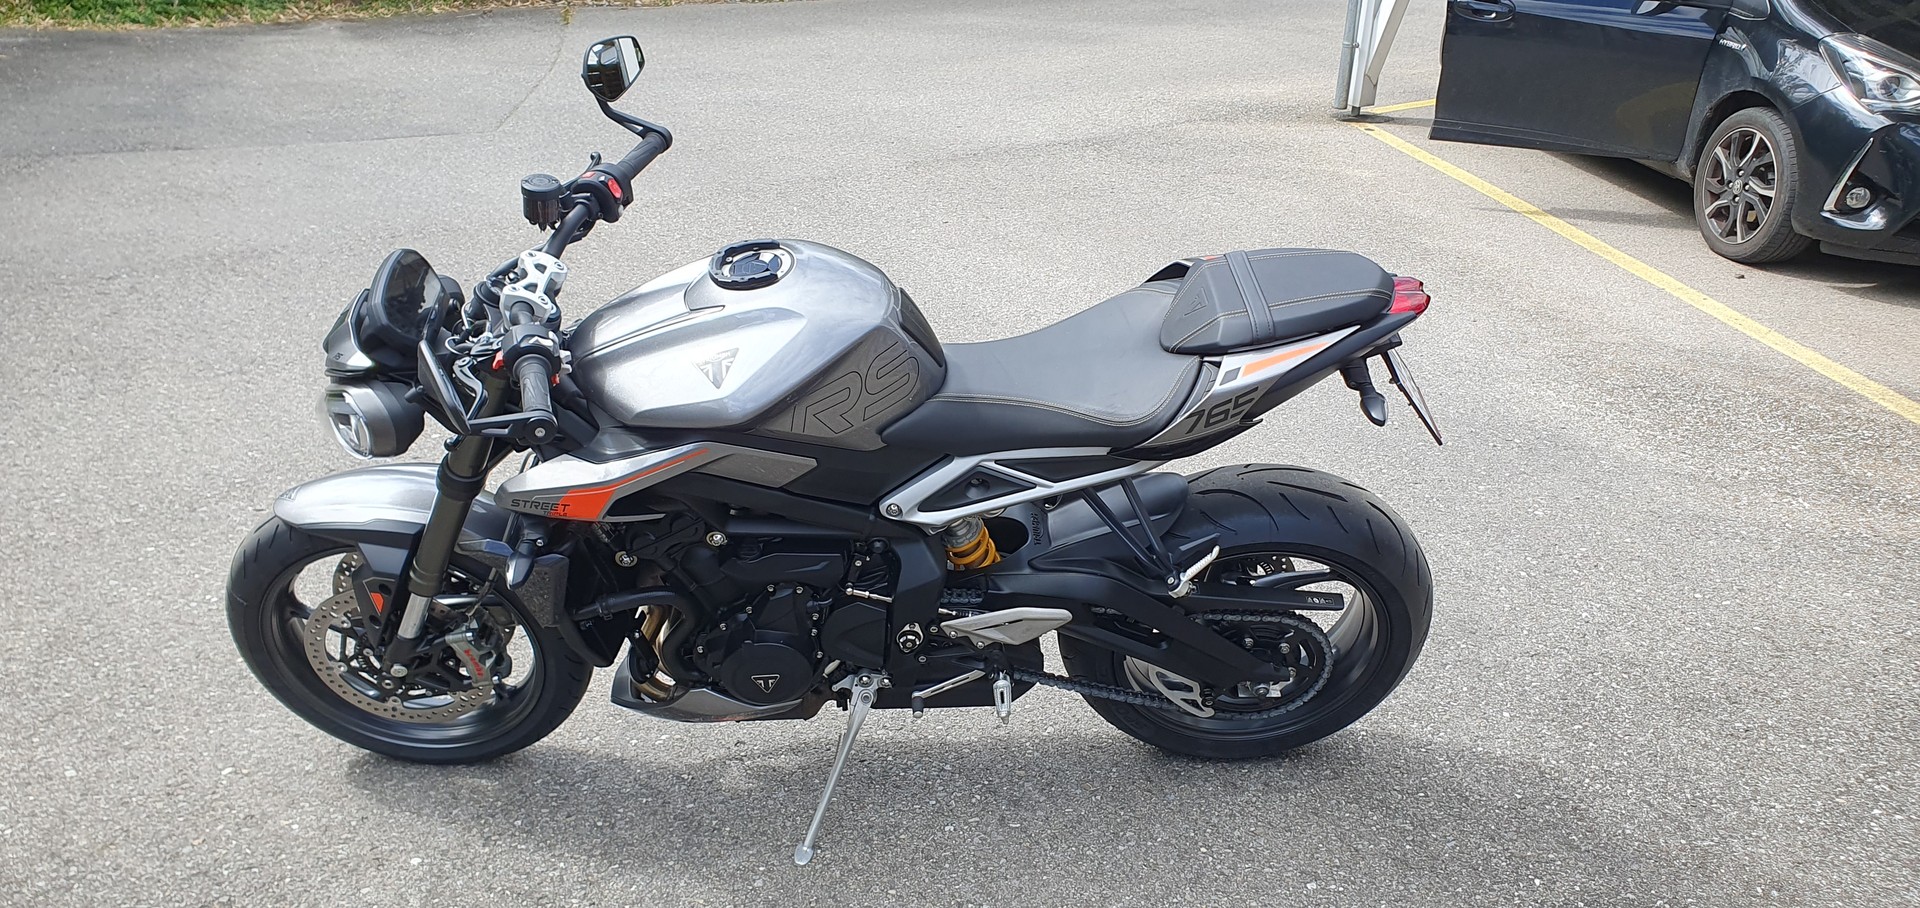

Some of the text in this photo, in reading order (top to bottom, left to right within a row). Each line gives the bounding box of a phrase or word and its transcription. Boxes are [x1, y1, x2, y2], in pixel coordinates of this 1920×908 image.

[791, 341, 919, 434] RS
[1185, 386, 1259, 435] 765
[510, 499, 571, 513] STREET
